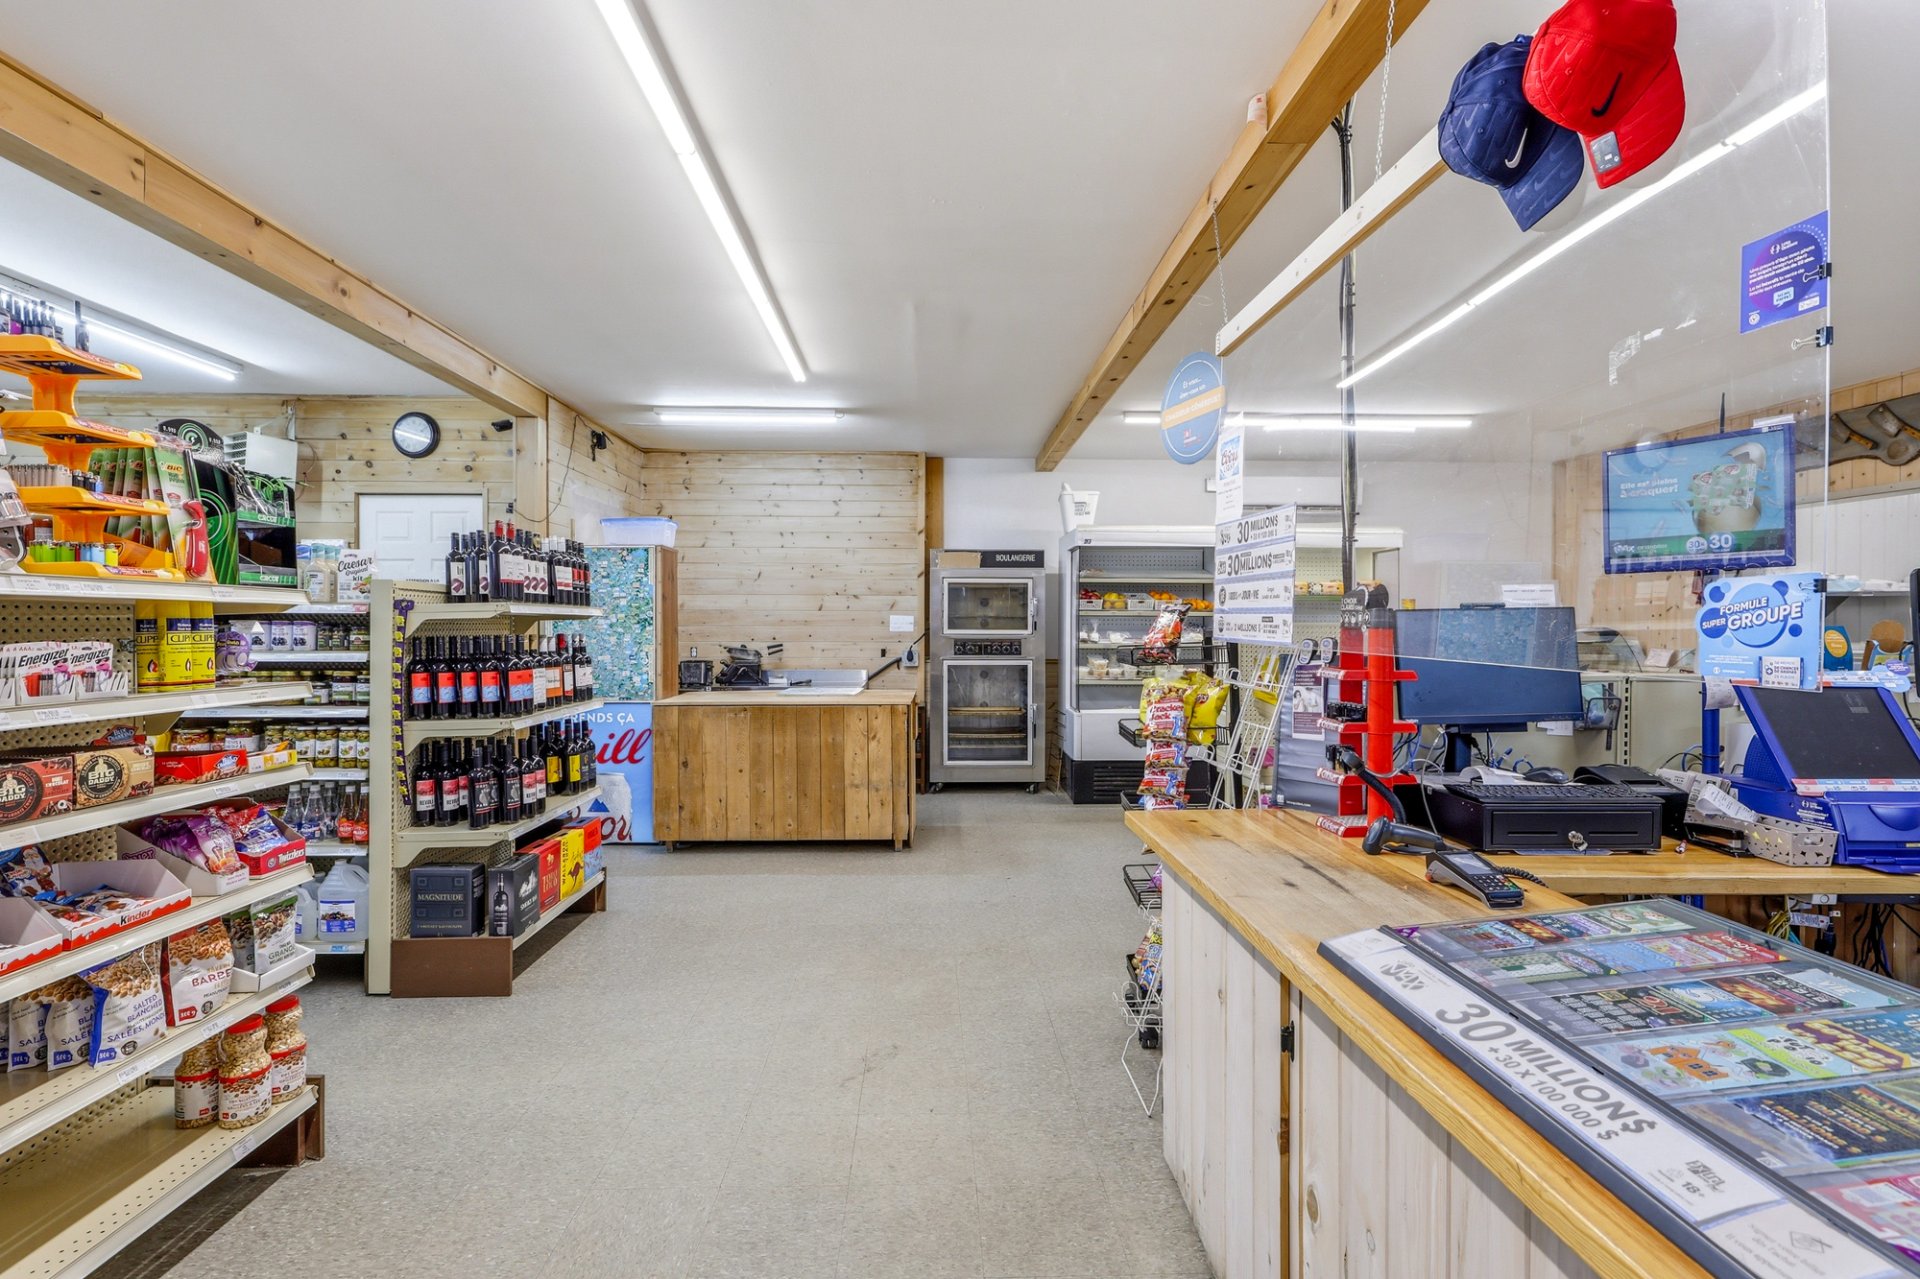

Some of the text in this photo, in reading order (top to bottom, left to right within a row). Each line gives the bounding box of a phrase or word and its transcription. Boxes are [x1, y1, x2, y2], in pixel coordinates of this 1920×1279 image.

[1237, 521, 1249, 543] 30
[1709, 534, 1732, 548] 30
[338, 557, 373, 572] Caesar
[995, 554, 1036, 562] BOULANGERIE
[1227, 554, 1240, 576] 30
[1720, 597, 1768, 615] FORMULE
[1702, 602, 1803, 631] SUPER GROUPE
[18, 648, 69, 668] Energizer
[70, 648, 111, 665] nergizer
[563, 713, 636, 726] RENDS ÇA
[88, 768, 115, 780] BIG
[88, 777, 115, 786] DADDY
[0, 793, 26, 802] ADDY
[278, 849, 304, 863] Twizzlers
[417, 893, 464, 901] MAGNITUDE
[120, 909, 152, 926] Kinder
[127, 999, 163, 1023] BLANCHED
[133, 994, 158, 1011] SALTED
[1435, 1003, 1658, 1134] 30 MILLION$
[1496, 1053, 1521, 1070] 30
[1528, 1078, 1567, 1102] 100
[1561, 1102, 1601, 1129] 000
[1596, 1128, 1621, 1141] $
